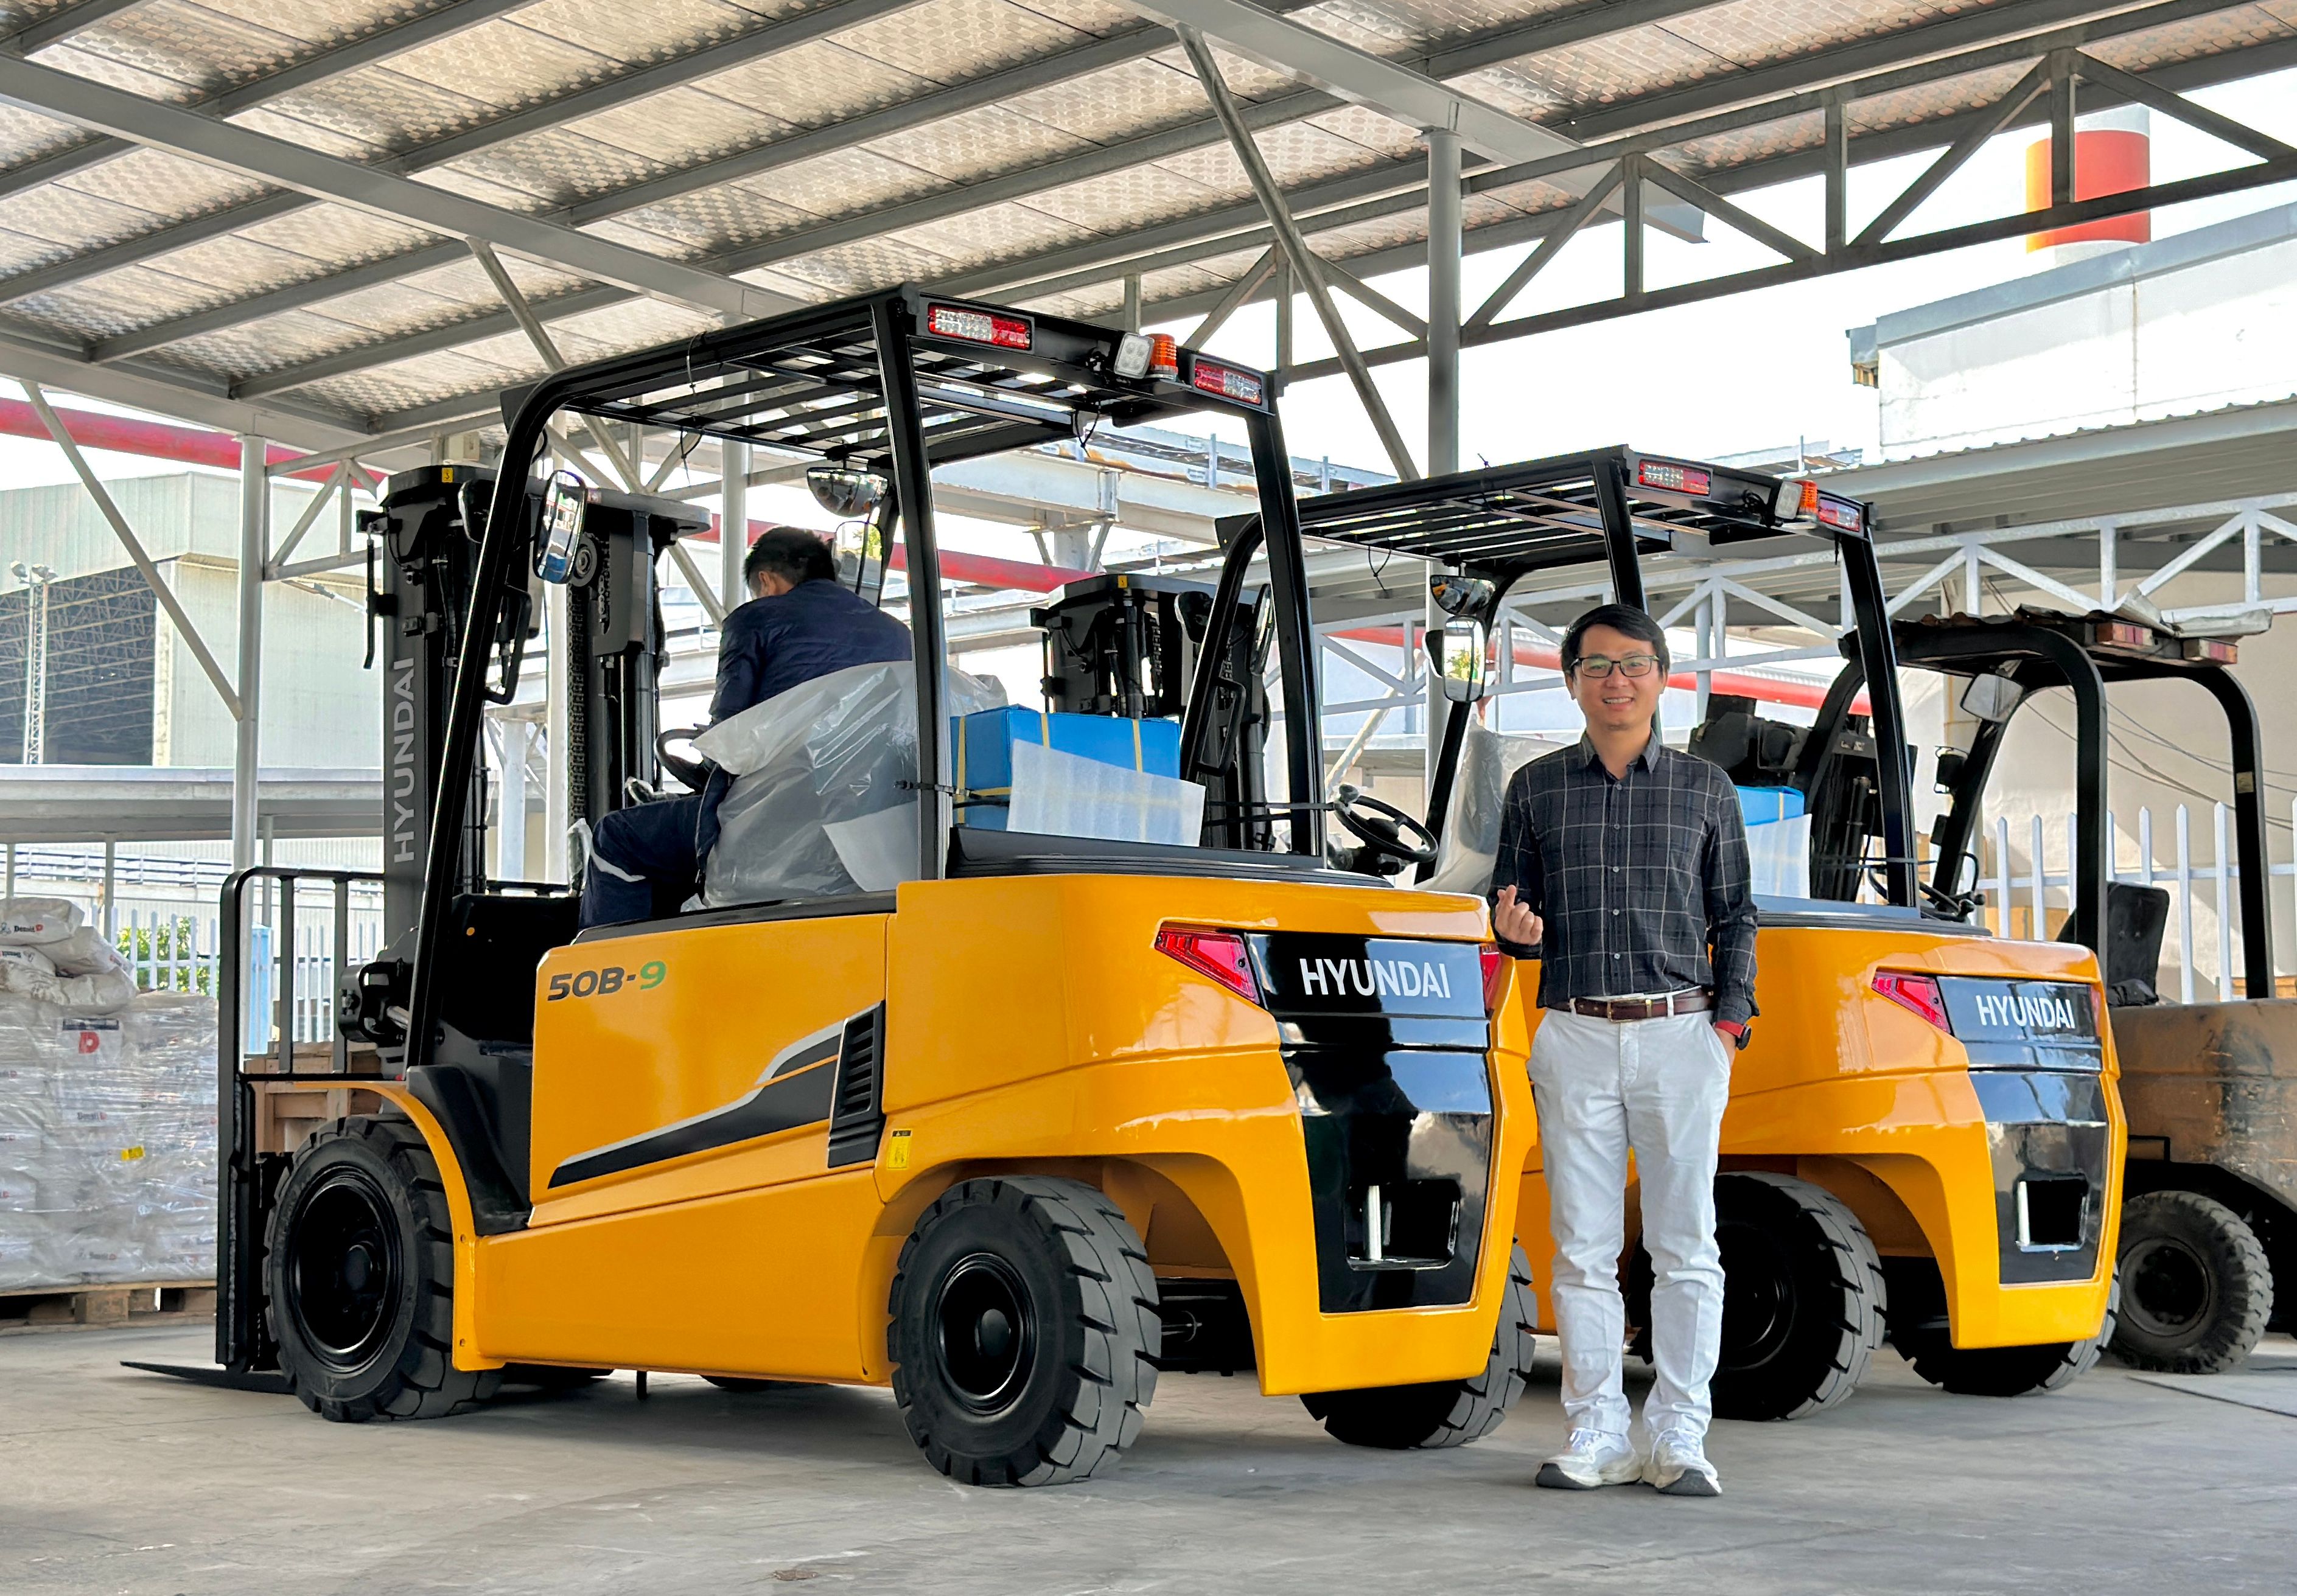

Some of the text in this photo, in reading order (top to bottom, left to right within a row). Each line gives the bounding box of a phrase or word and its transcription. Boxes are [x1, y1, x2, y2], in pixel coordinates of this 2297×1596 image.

[394, 658, 414, 863] HYUNDAI
[1299, 958, 1450, 998] HYUNDAI
[1976, 995, 2075, 1028] HYUNDAI
